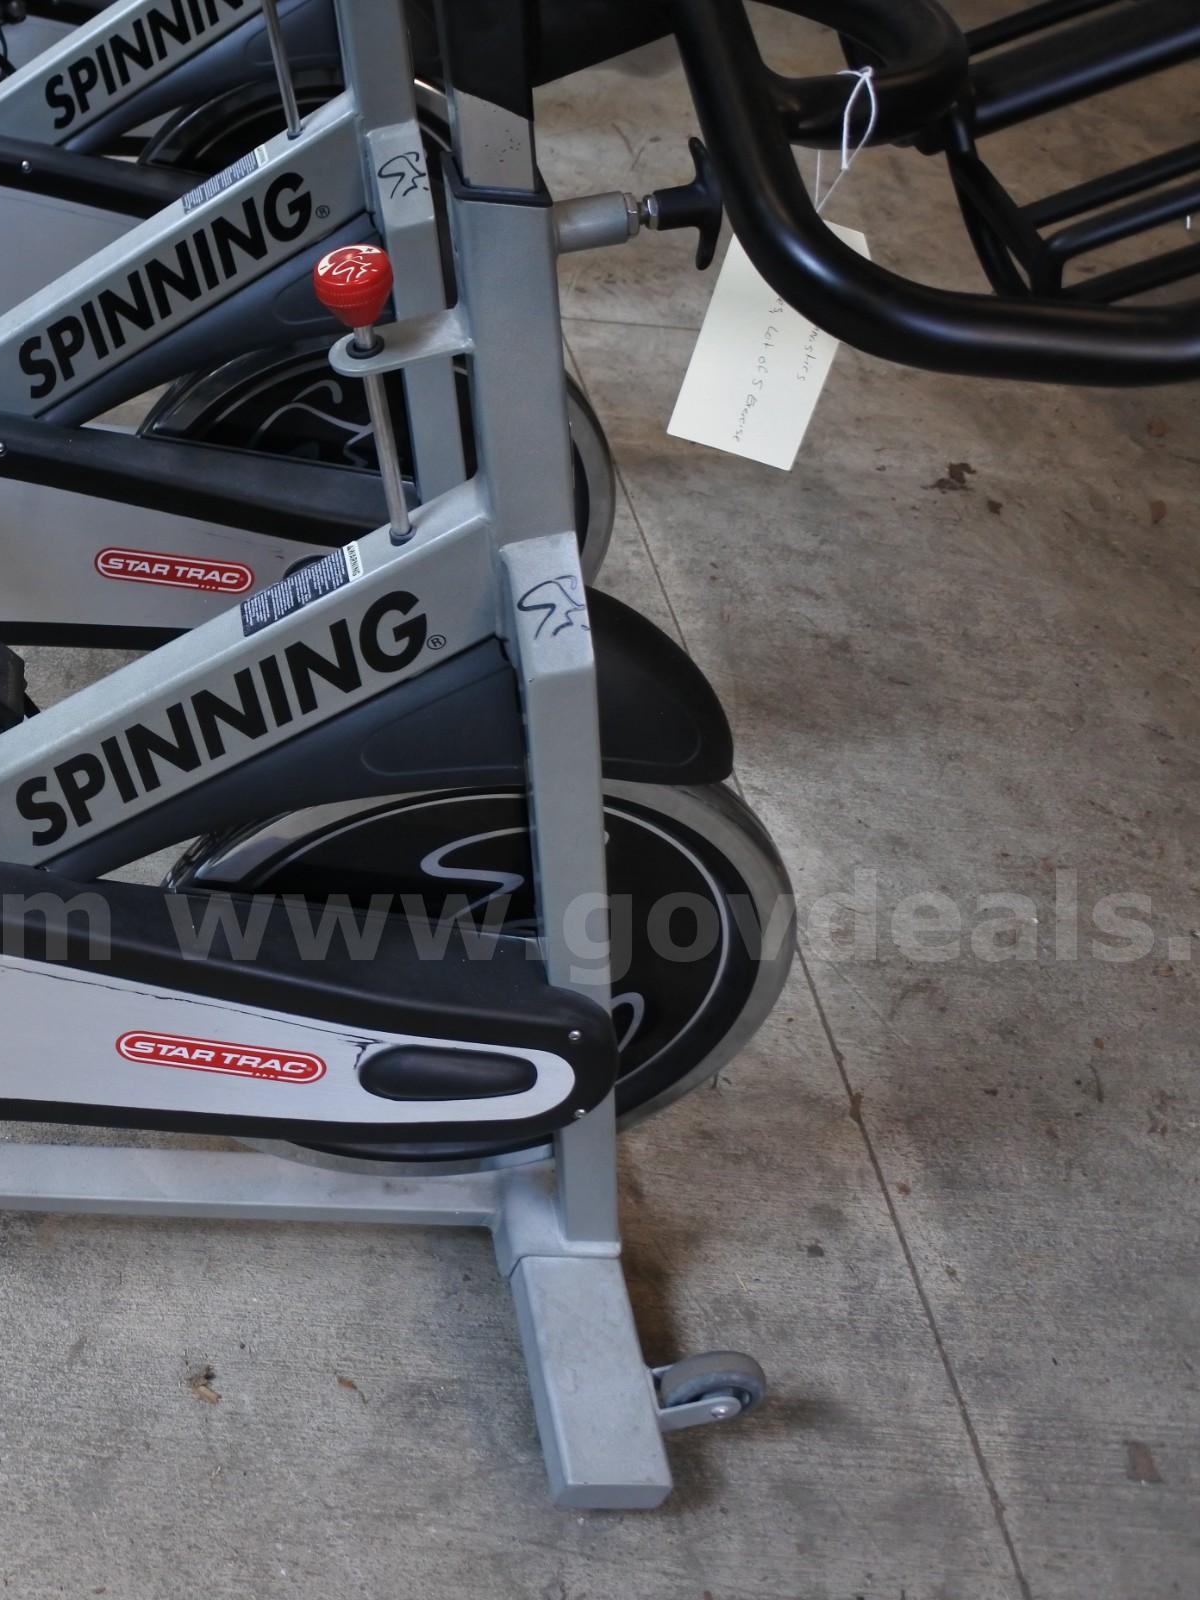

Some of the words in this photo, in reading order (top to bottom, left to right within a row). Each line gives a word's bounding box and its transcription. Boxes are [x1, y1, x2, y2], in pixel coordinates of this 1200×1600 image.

[18, 171, 312, 398] SPINNING
[107, 557, 170, 576] STAR
[174, 565, 241, 584] TRAC
[348, 549, 361, 577] WARNING
[15, 590, 428, 846] SPINNING
[134, 1041, 215, 1062] STAR
[221, 1052, 307, 1073] TRAC
